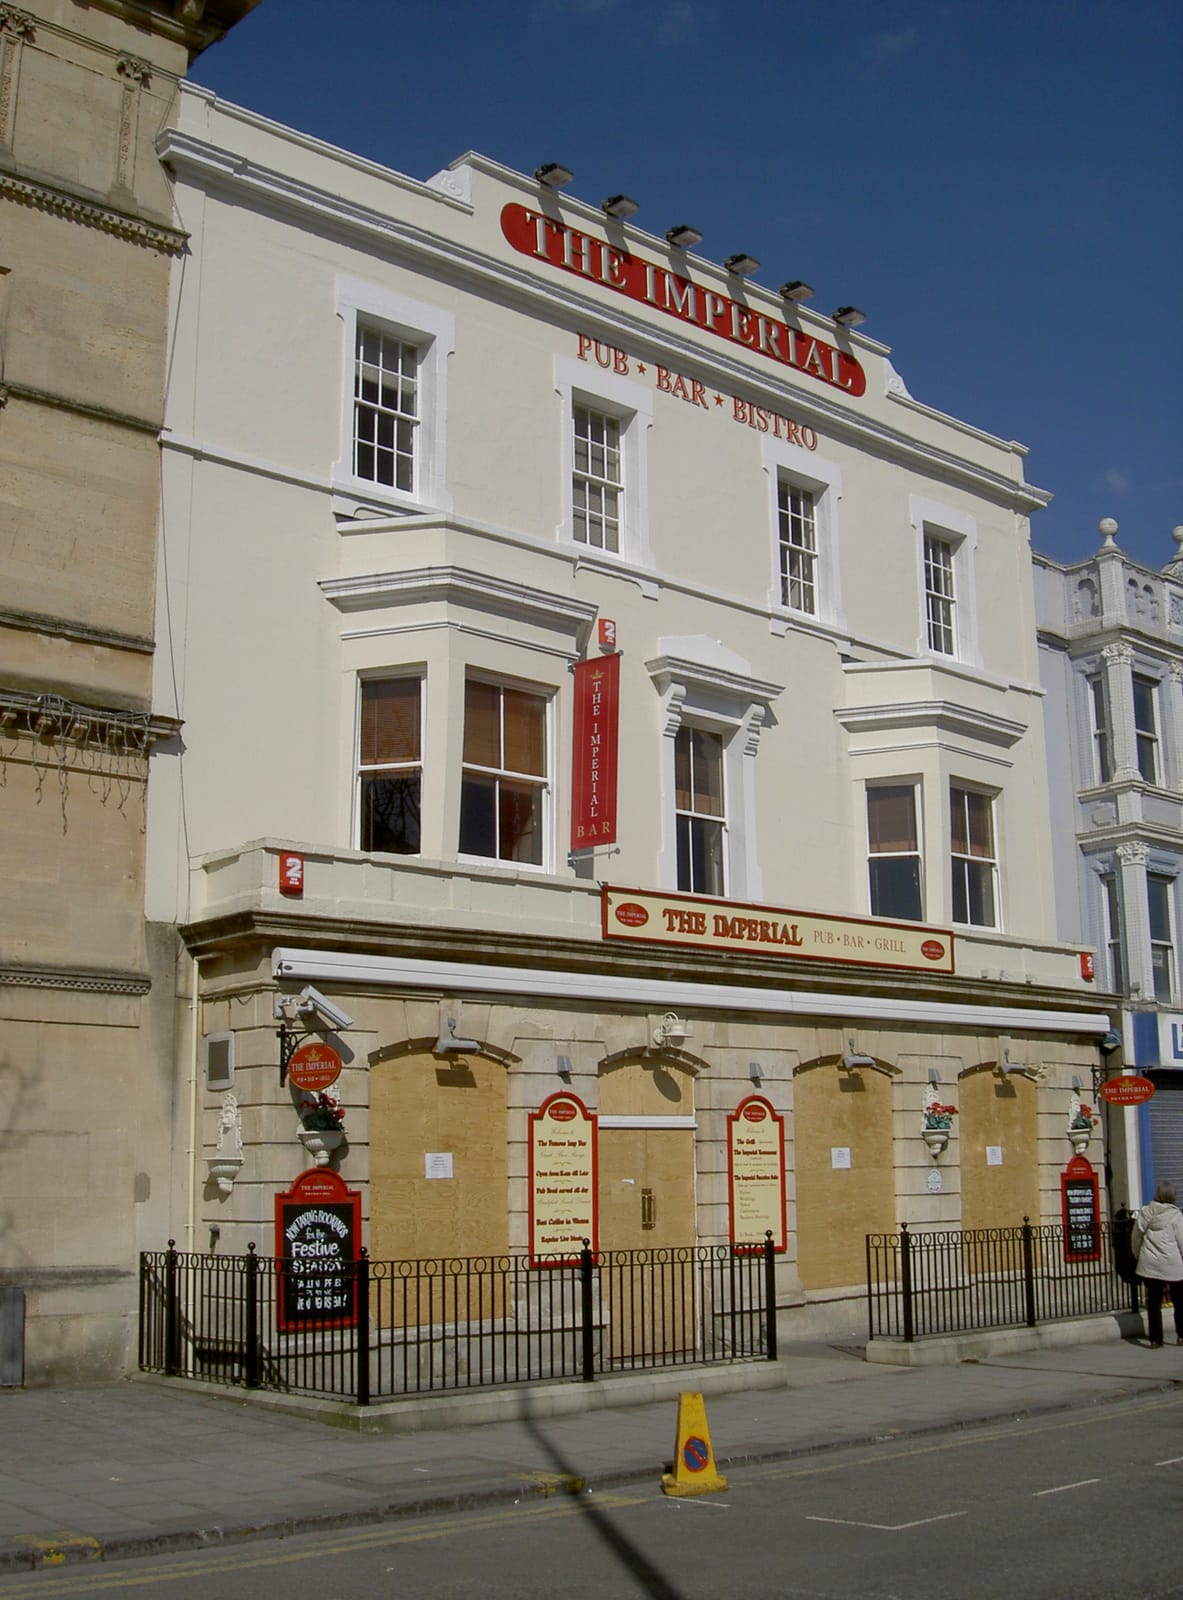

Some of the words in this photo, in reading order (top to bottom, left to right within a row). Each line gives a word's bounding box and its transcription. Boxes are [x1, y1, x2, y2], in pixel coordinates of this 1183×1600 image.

[526, 210, 628, 289] THE
[642, 261, 853, 391] IMPERIAL
[577, 332, 629, 376] PUB
[656, 363, 710, 409] BAR
[732, 394, 819, 452] BISTRO
[605, 621, 615, 638] 2
[591, 681, 602, 716] THE
[590, 723, 602, 818] IMPERIAL
[577, 820, 611, 839] BAR
[286, 857, 302, 878] 2
[662, 908, 707, 936] THE
[713, 914, 803, 947] IMPERIAL
[813, 930, 835, 945] PUB
[843, 933, 865, 949] BAR
[874, 937, 907, 954] GRILL
[291, 1063, 305, 1072] THE
[305, 1060, 337, 1071] IMPERIAL
[538, 1139, 547, 1147] The
[285, 1222, 300, 1241] NOW
[295, 1209, 319, 1229] TAKING
[318, 1209, 349, 1238] BOOKINGS
[292, 1239, 341, 1258] Festive
